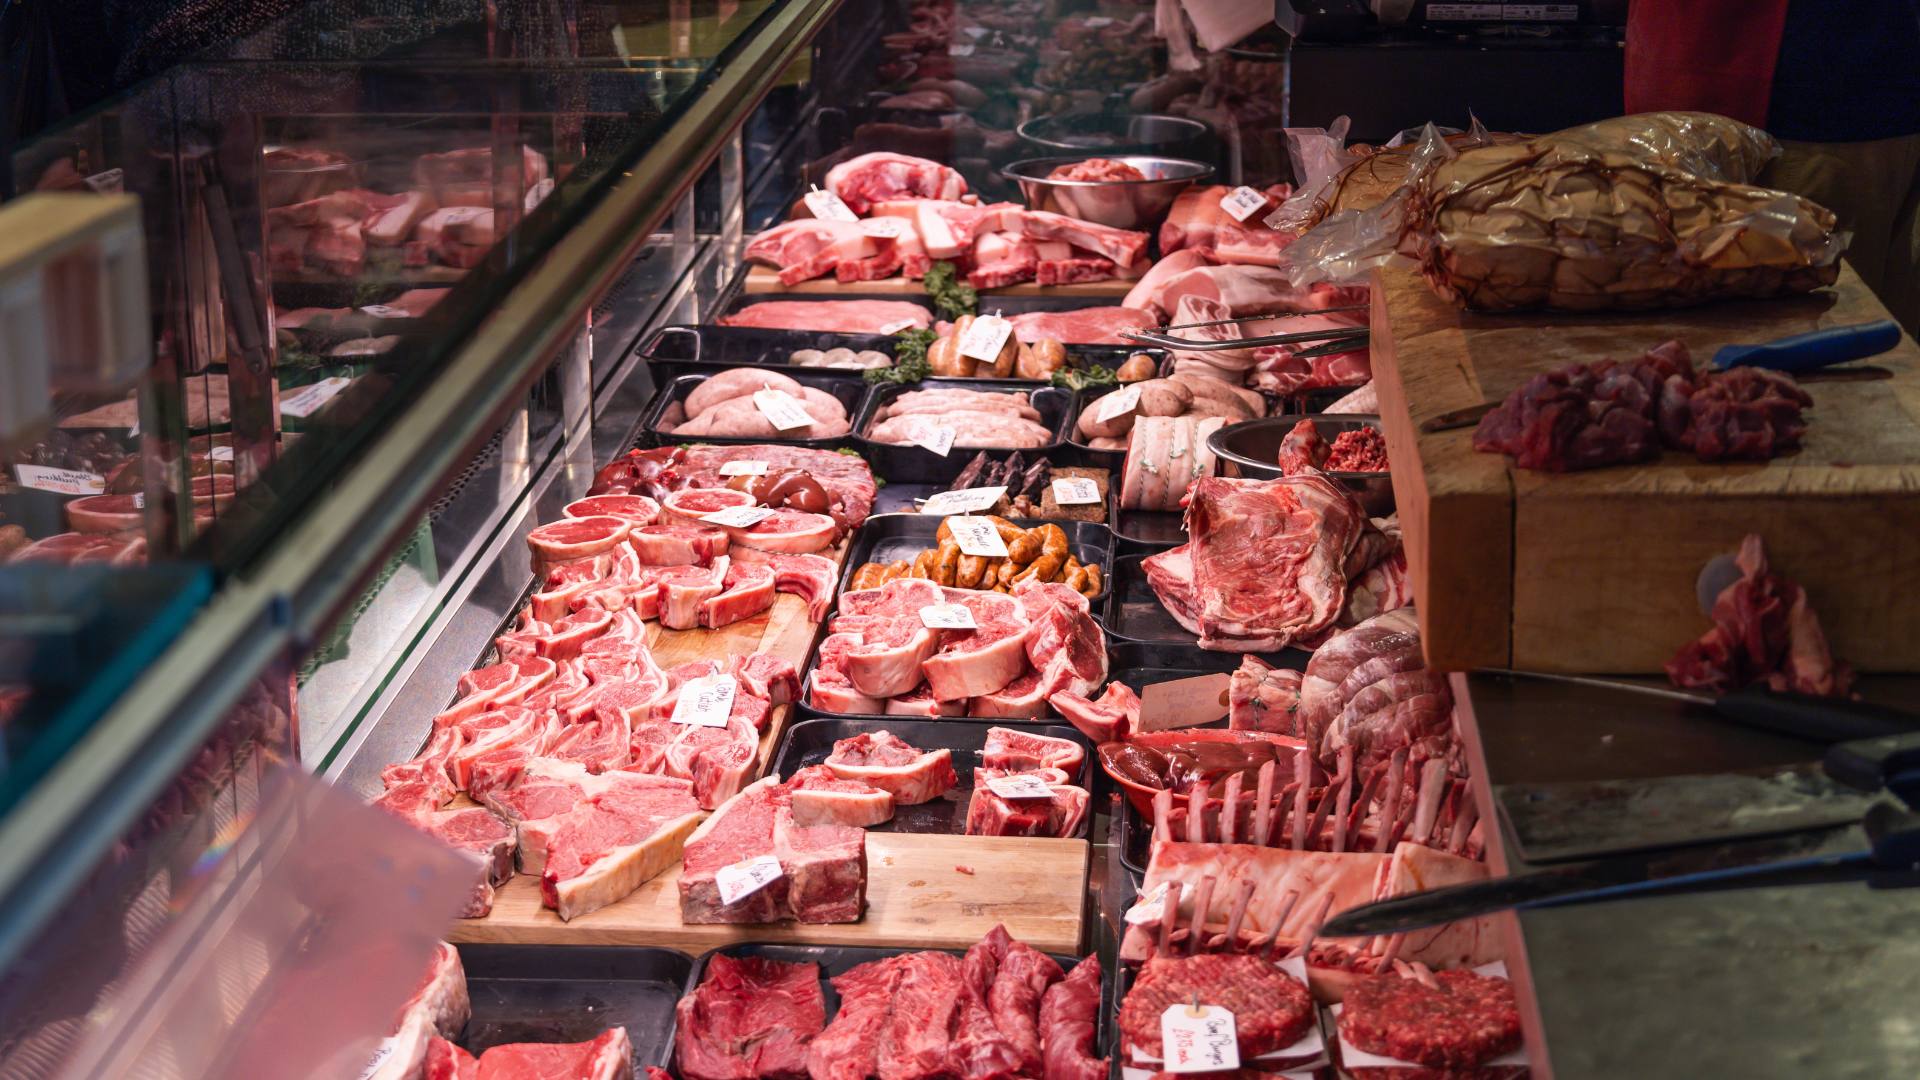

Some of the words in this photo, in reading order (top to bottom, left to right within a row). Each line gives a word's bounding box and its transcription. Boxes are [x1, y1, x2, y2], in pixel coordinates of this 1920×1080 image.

[714, 682, 733, 703] Lamb
[1203, 1019, 1228, 1037] Beef
[1204, 1037, 1232, 1066] Burgers
